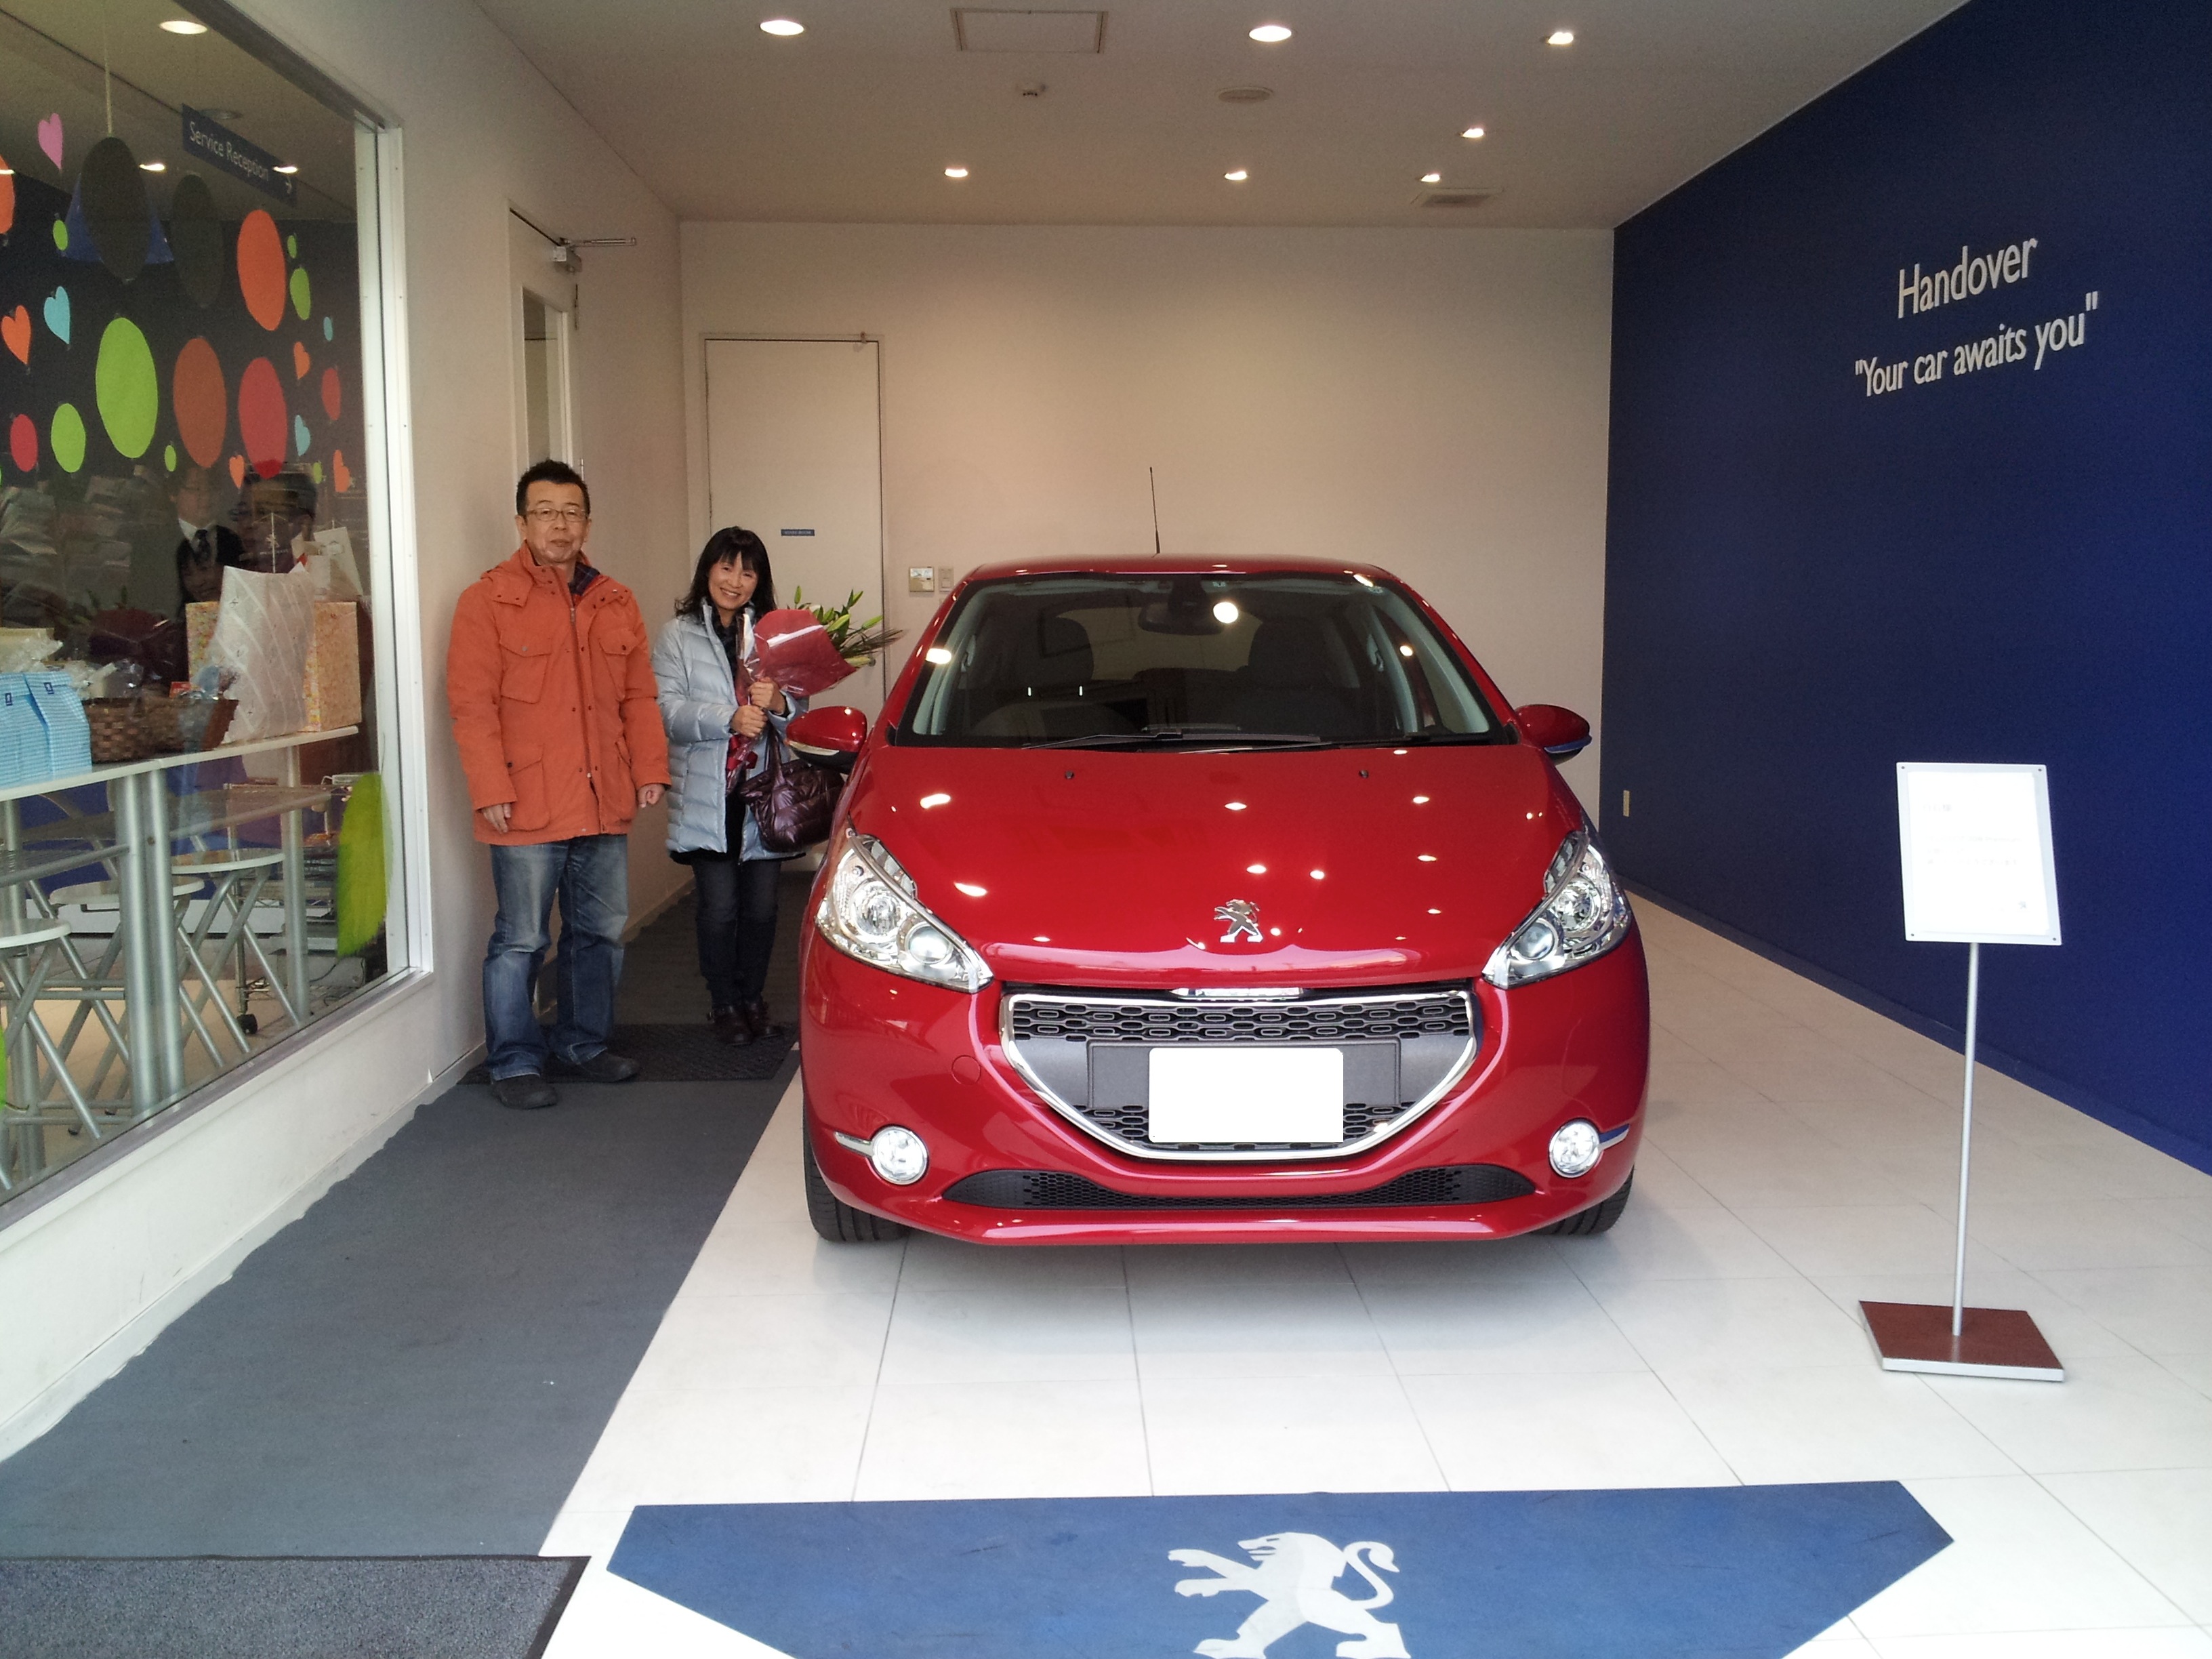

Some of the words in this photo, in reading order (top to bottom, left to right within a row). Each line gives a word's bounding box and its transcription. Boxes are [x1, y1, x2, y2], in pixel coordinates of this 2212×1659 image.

[190, 121, 224, 157] Service
[226, 141, 269, 182] Reception
[1898, 238, 2039, 319] Handover
[1855, 356, 1909, 397] "Your
[1914, 350, 1948, 384] car
[1954, 323, 2027, 375] awaits
[2034, 291, 2098, 371] you"
